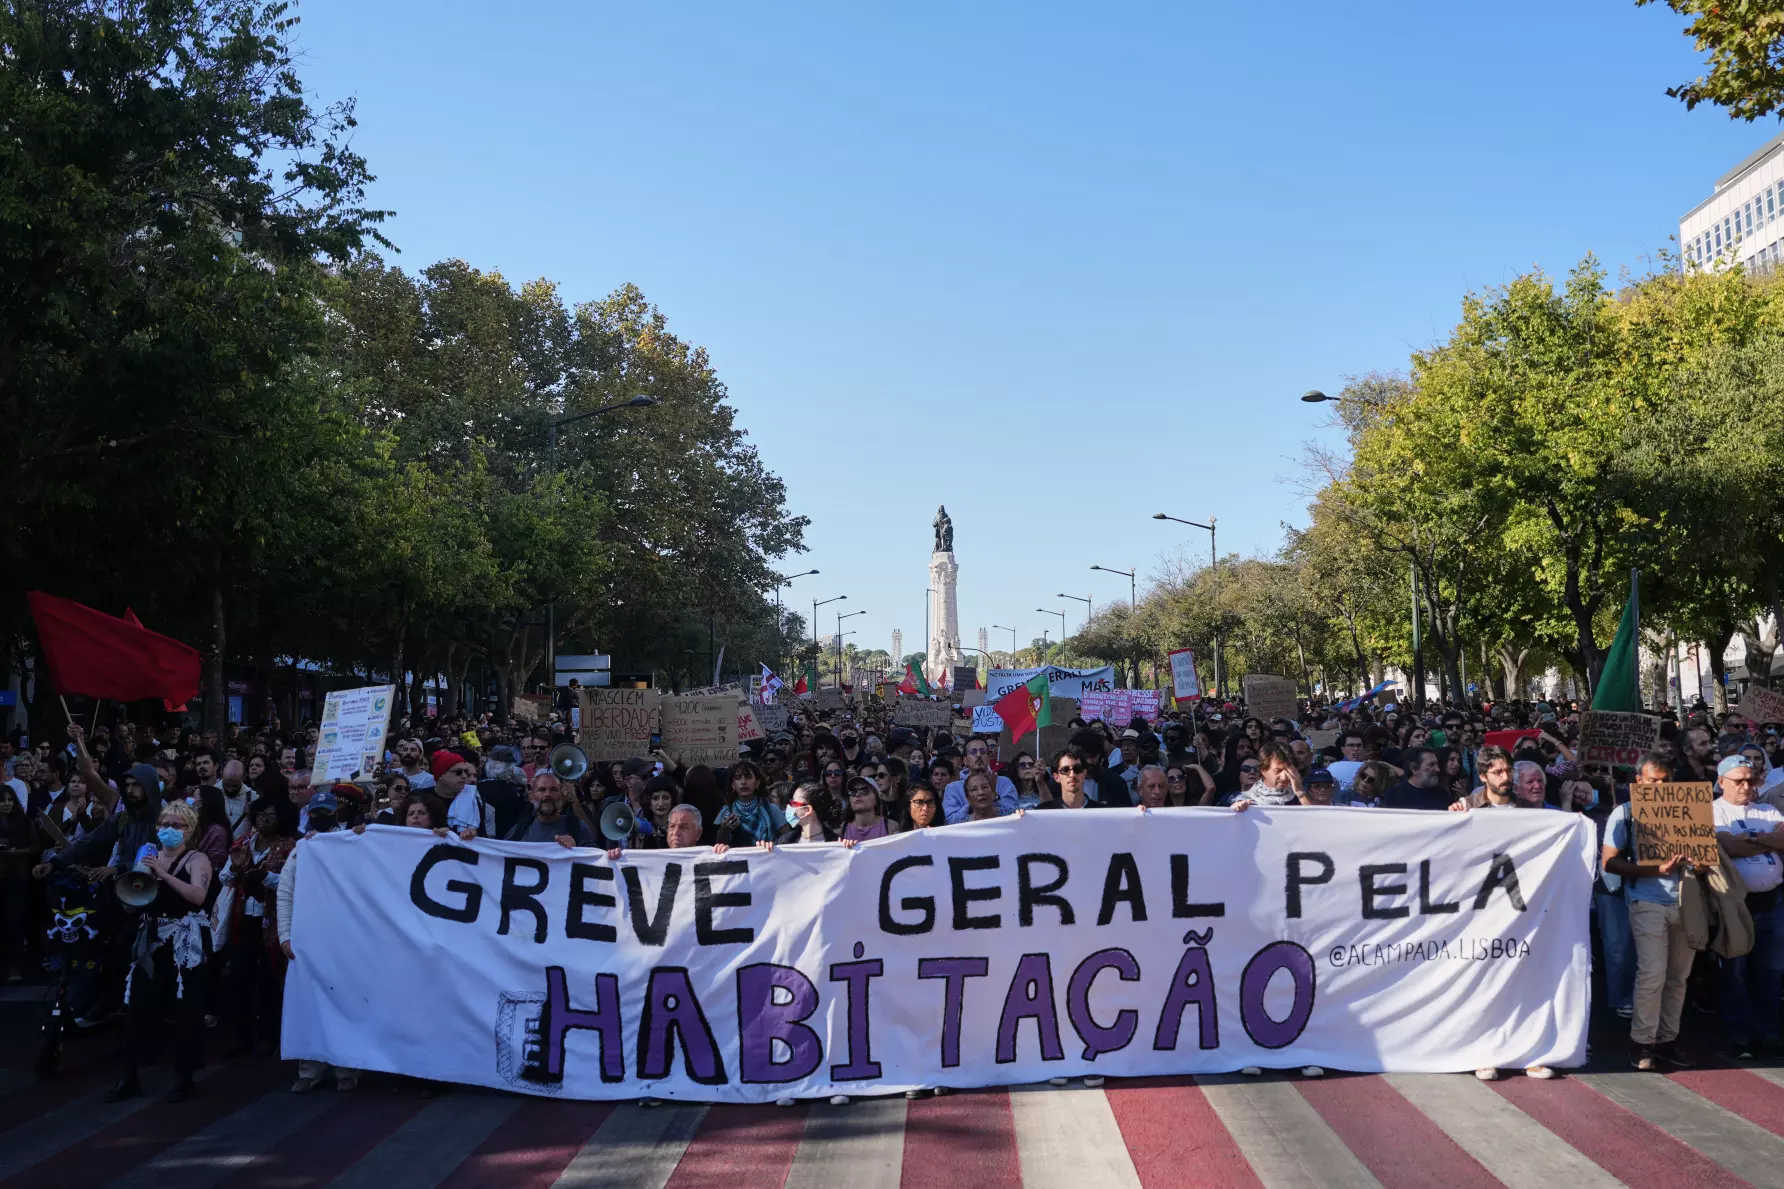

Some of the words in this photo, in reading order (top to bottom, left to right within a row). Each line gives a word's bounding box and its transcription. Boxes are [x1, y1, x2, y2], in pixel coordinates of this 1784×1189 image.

[581, 707, 657, 729] LIBERDADE
[582, 729, 600, 740] MAS
[714, 747, 738, 761] VIVER
[1635, 784, 1713, 803] SENHORIOS
[1638, 808, 1649, 819] A
[1651, 805, 1693, 821] VIVER
[1636, 822, 1670, 838] ACIMA
[1673, 824, 1688, 838] DAS
[1689, 823, 1717, 839] NOSSAS
[410, 844, 755, 946] GREVE
[878, 852, 1226, 935] GERAL
[1285, 851, 1529, 919] PELA
[1328, 937, 1531, 968] @ACAMPADA.LISBOA
[544, 926, 1317, 1085] HABITAÇÃO
